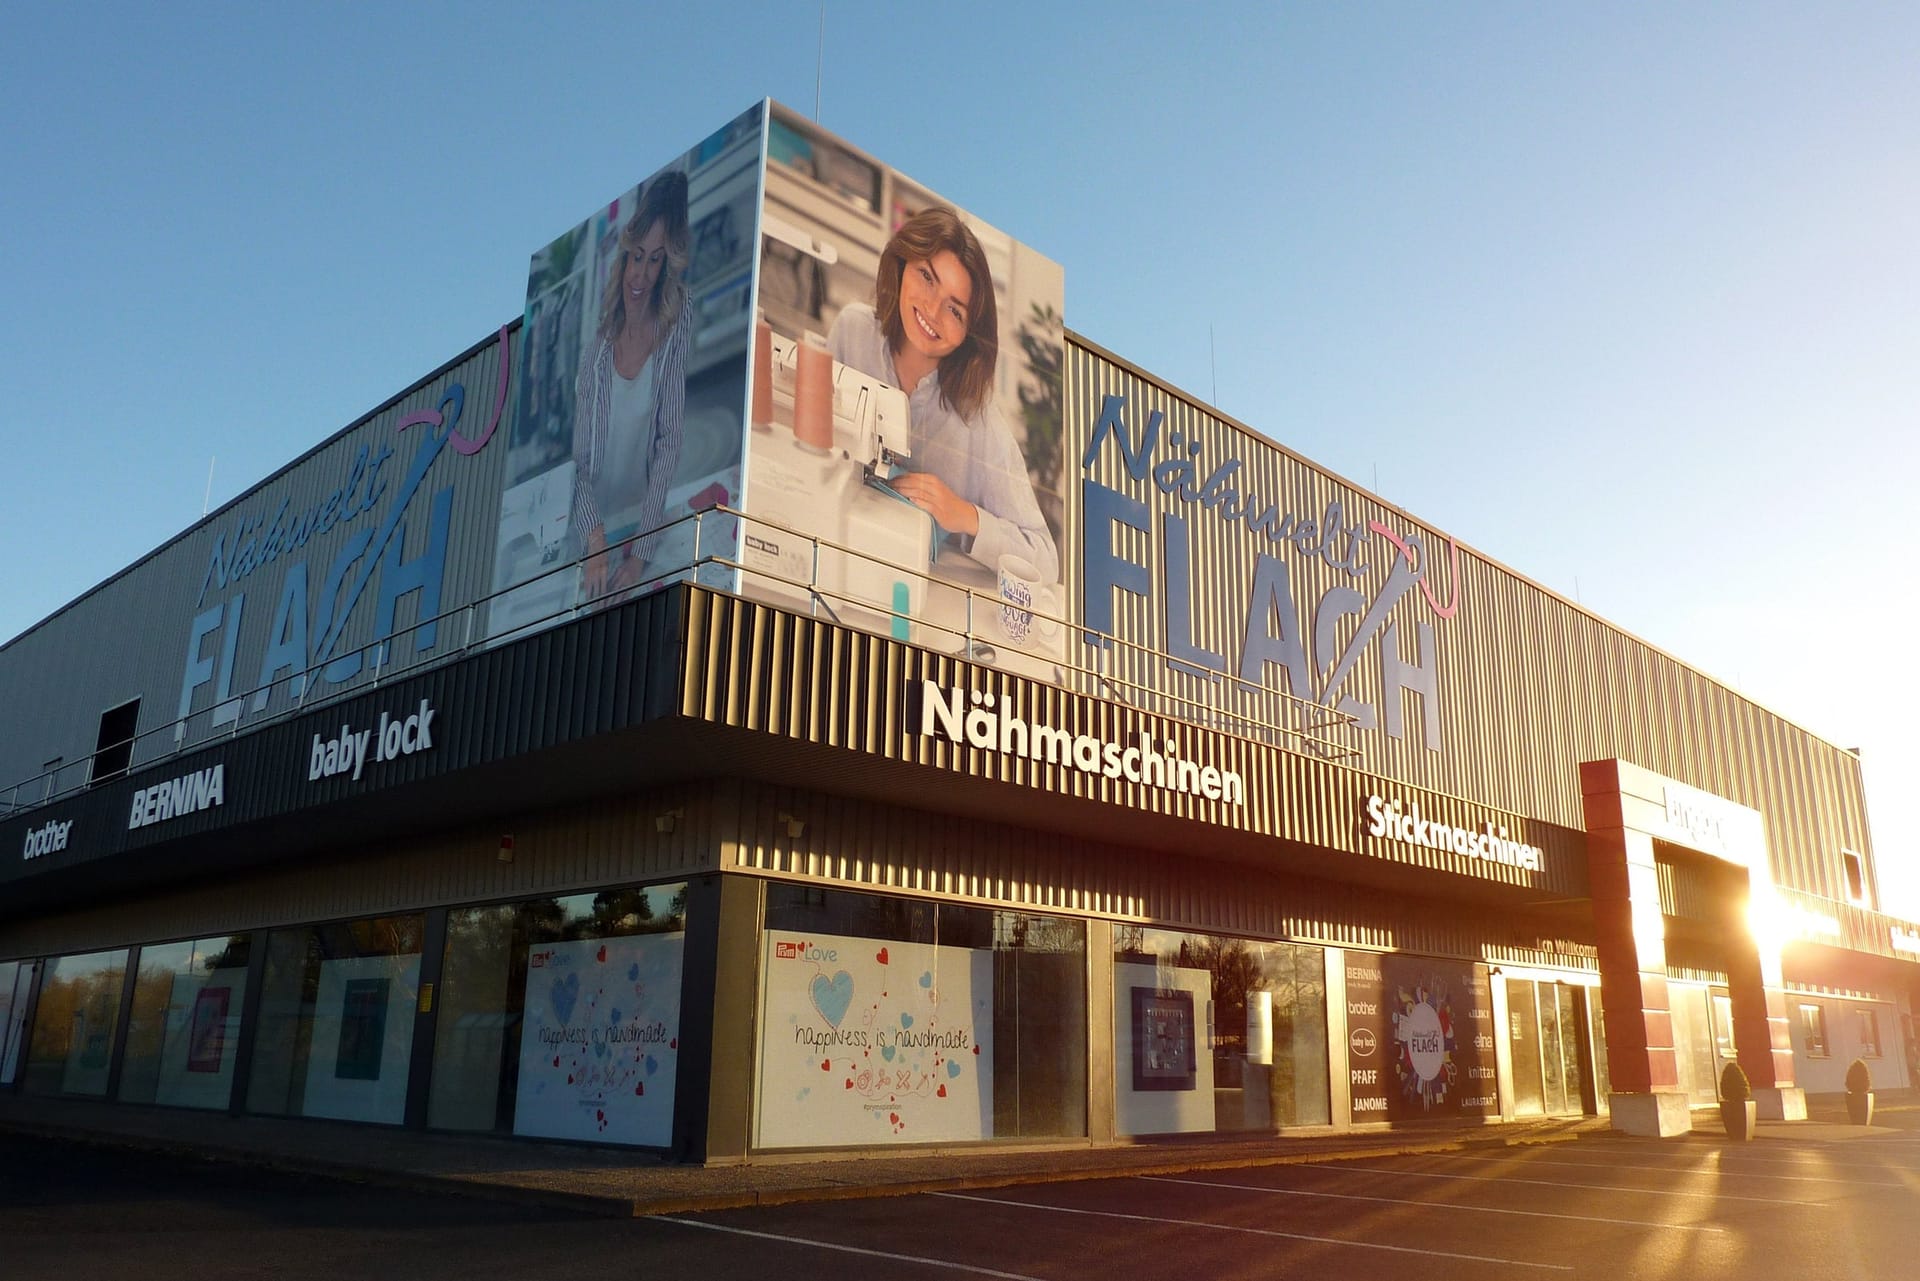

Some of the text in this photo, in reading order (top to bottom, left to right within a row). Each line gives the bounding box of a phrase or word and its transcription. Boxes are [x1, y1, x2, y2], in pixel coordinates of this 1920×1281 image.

[1083, 394, 1371, 578] Nähwelt
[197, 444, 396, 608] Nähwelt
[174, 475, 455, 743] FLACH
[1083, 478, 1442, 753] FLACH
[308, 698, 437, 782] baby lock
[921, 680, 1243, 806] Nähmaschinen
[128, 763, 225, 830] BERNINA
[23, 817, 74, 860] brother
[1367, 795, 1546, 873] Stickmaschinen
[804, 946, 838, 962] Love
[1346, 967, 1383, 982] BERNINA
[1348, 1001, 1377, 1016] brother
[874, 1027, 886, 1047] is
[1352, 1038, 1375, 1049] baby lock
[1412, 1038, 1439, 1053] FLACH
[1351, 1069, 1378, 1085] PFAFF
[1467, 1065, 1496, 1079] knittax
[1353, 1097, 1389, 1112] JANOME
